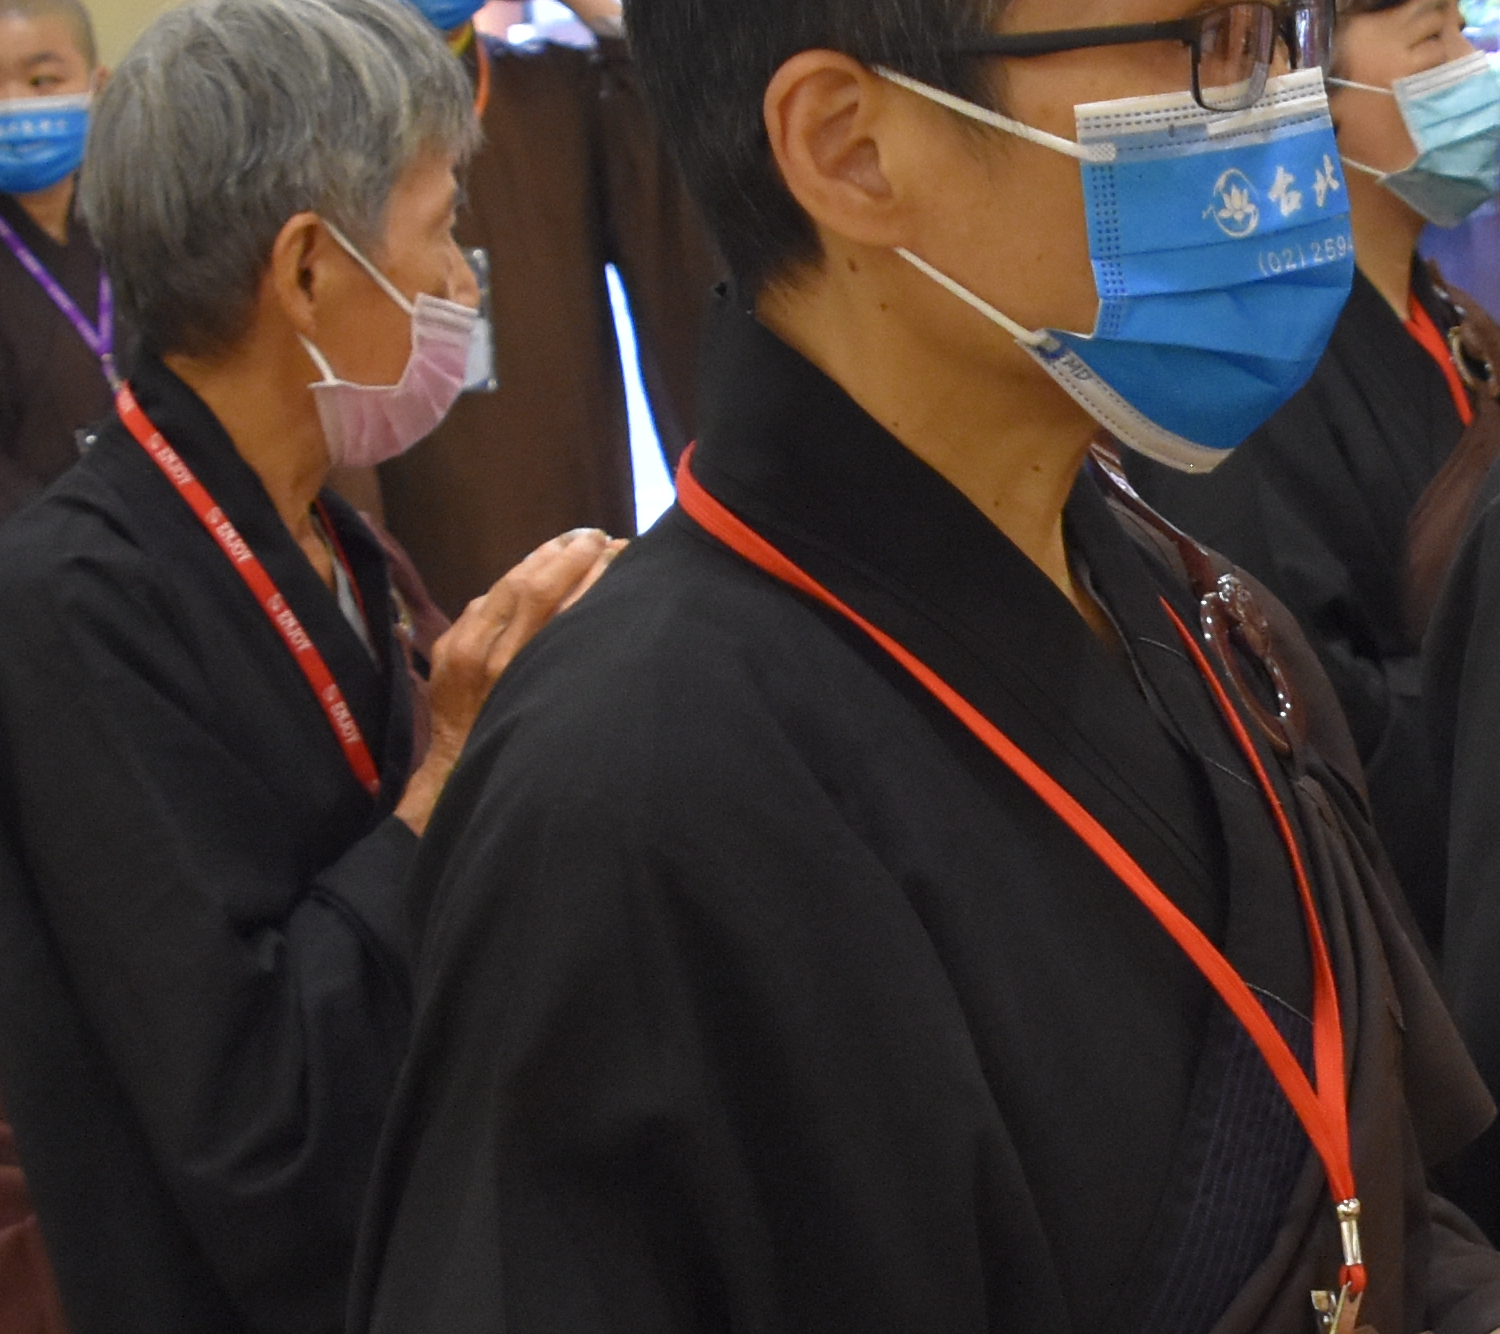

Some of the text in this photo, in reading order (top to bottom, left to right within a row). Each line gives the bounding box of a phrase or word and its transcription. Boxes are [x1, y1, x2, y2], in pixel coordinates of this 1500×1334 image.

[216, 521, 253, 563] ENJOY
[277, 609, 313, 651] ENJOY
[330, 701, 362, 744] ENJOY
